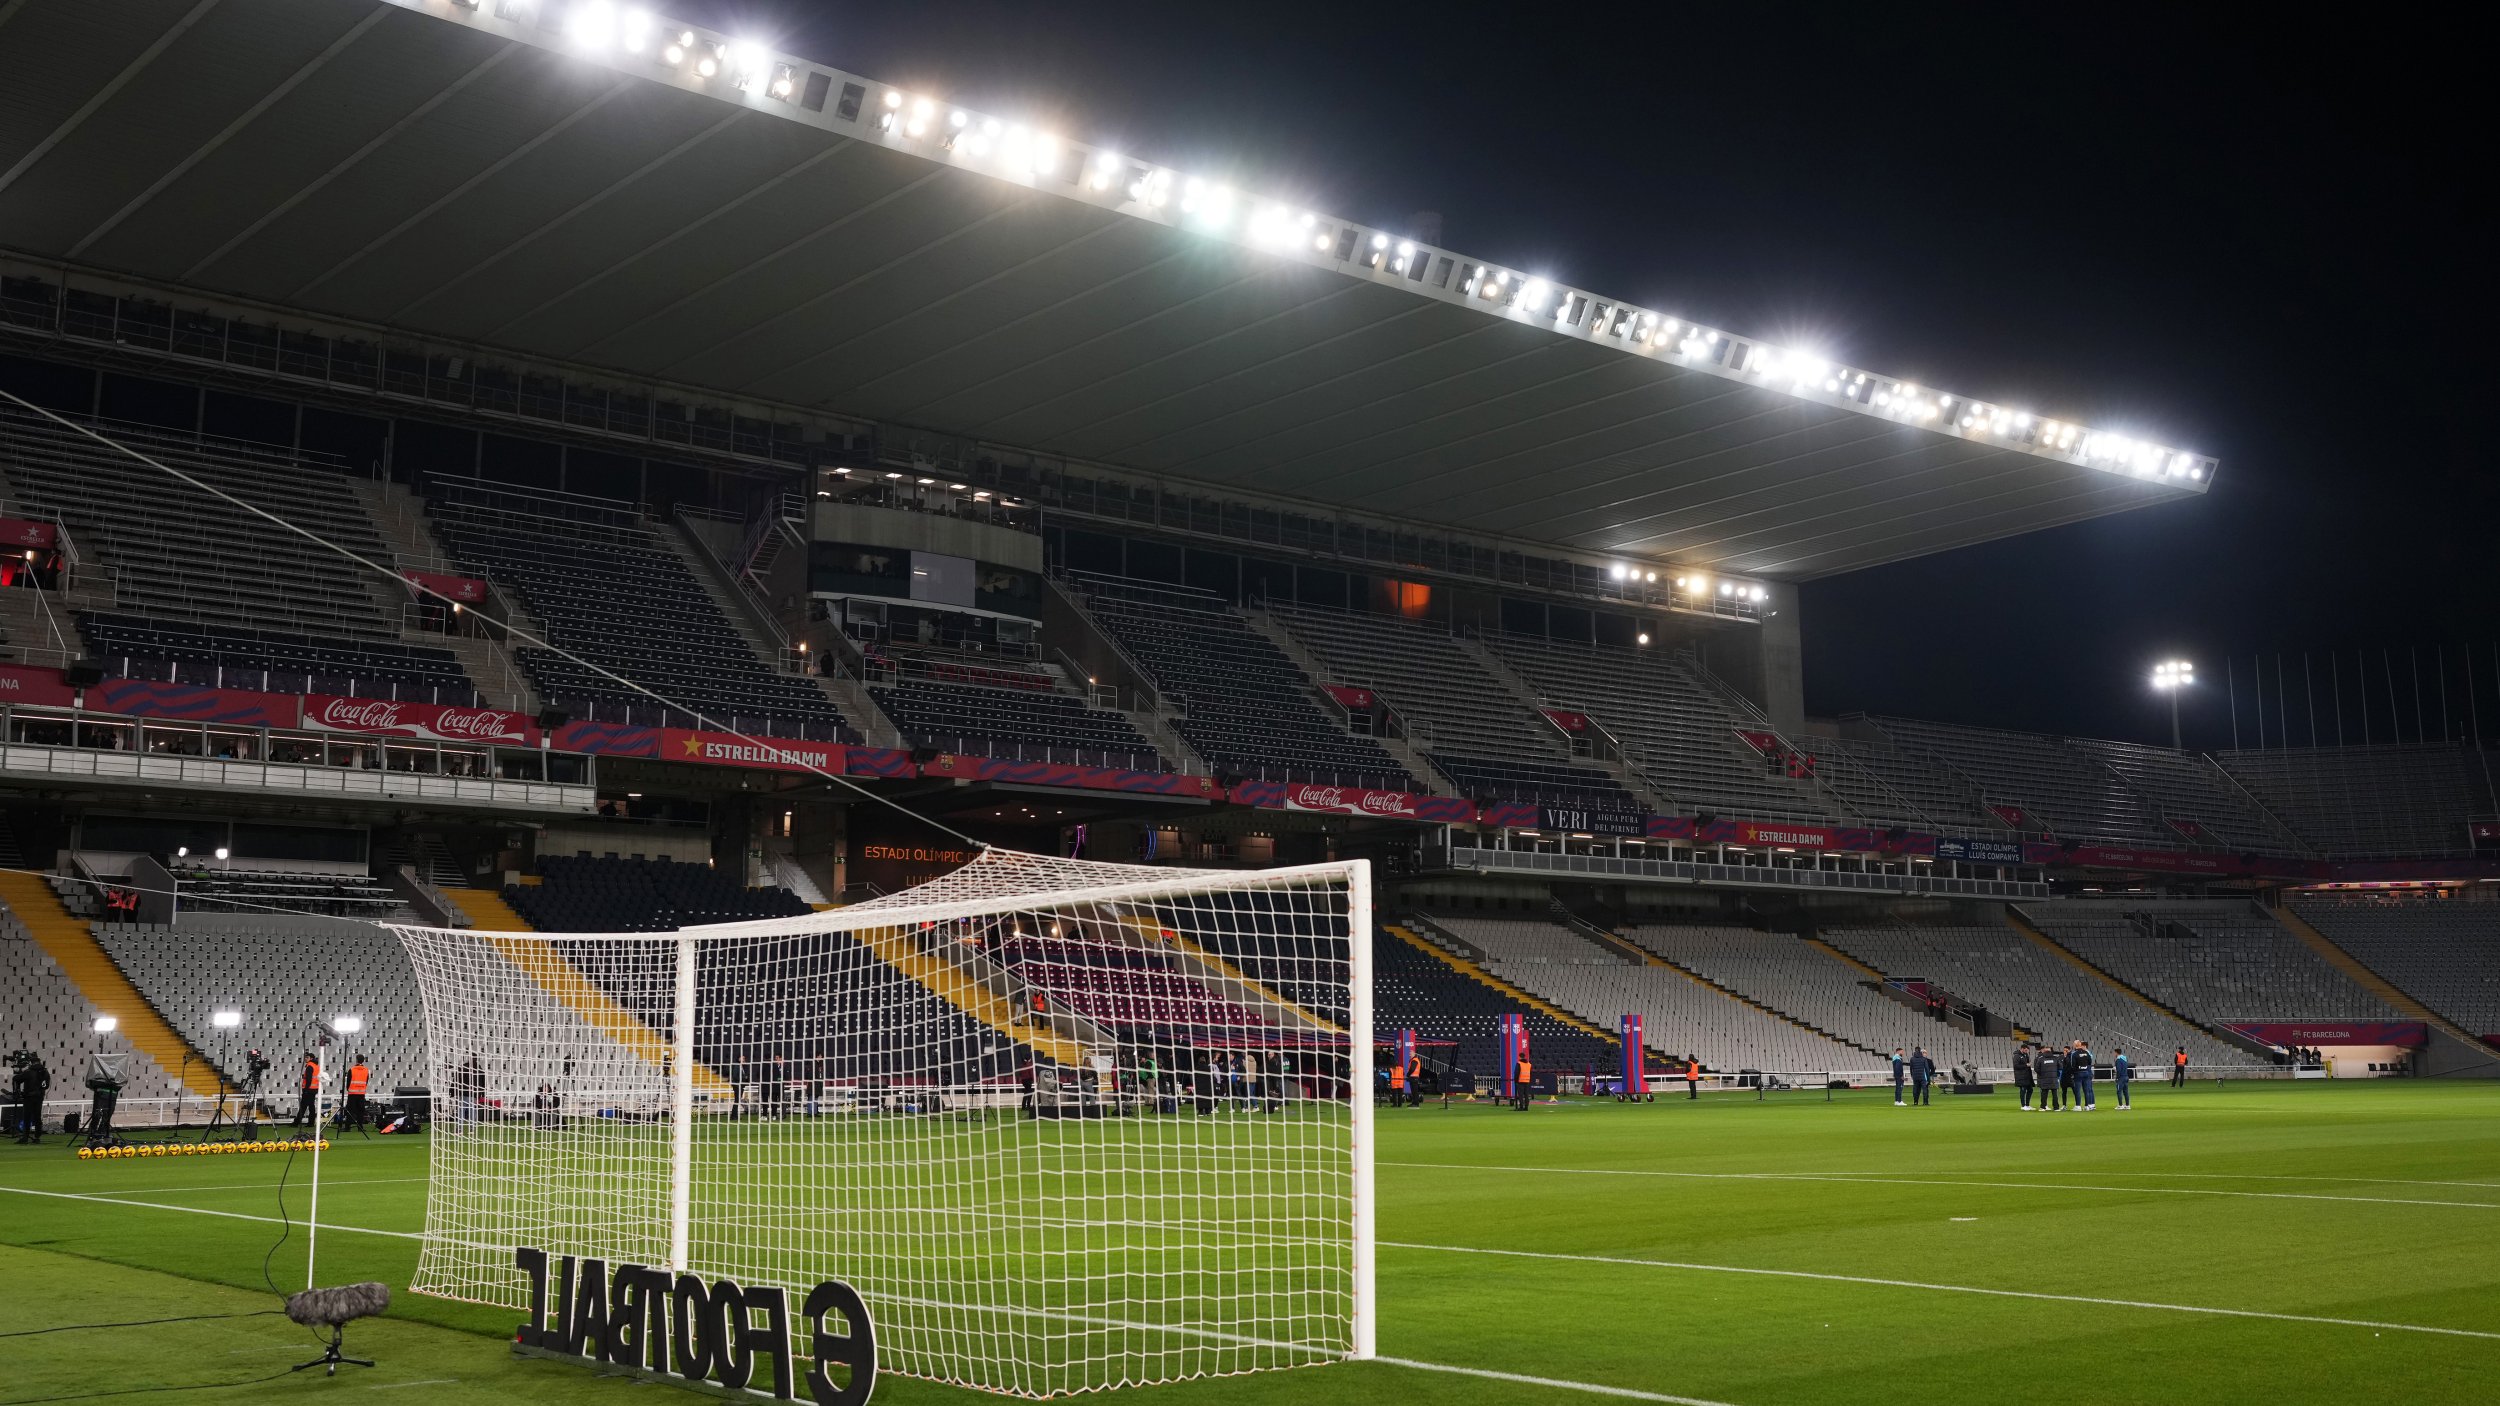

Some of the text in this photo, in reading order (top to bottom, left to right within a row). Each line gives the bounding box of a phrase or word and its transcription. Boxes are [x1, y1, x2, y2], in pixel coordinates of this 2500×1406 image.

[705, 742, 828, 768] ESTRELLA DAMM
[1546, 808, 1588, 830] VERI
[1596, 813, 1639, 824] AIGUA PURA
[1594, 823, 1640, 834] DEL PIRINEU
[1759, 831, 1824, 845] ESTRELLA DAMM
[1971, 842, 1992, 851] ESTADI
[865, 846, 910, 860] ESTADI
[914, 847, 964, 863] OLÍMPIC
[1987, 852, 2020, 862] COMPANYS
